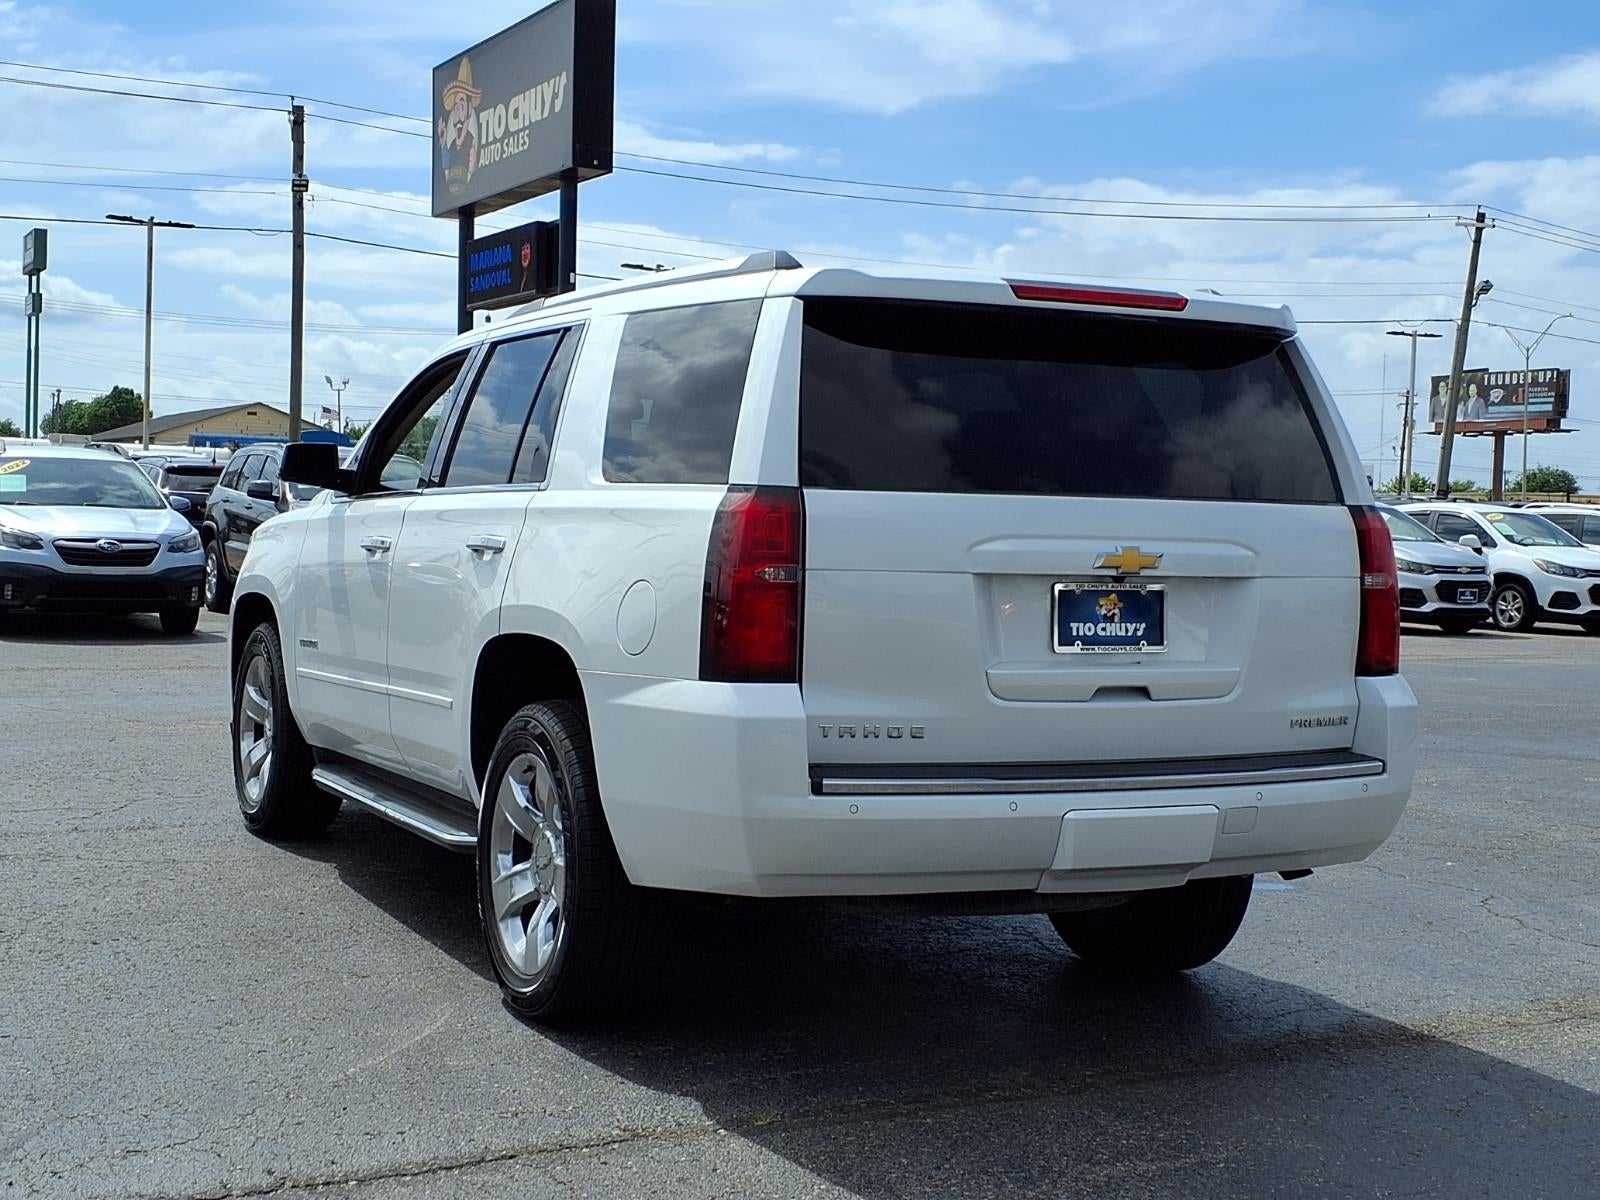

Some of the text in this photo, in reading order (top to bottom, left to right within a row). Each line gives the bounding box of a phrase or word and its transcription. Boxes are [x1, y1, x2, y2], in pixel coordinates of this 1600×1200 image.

[479, 71, 567, 145] TIO CHUY'S
[478, 129, 530, 168] AUTO SALES
[470, 243, 513, 273] MARIANA
[470, 267, 513, 293] SANDOVAL
[1483, 369, 1557, 386] THUNDER UP!
[1070, 622, 1146, 636] TIO CHUY'S
[818, 724, 926, 739] TAHOE
[1289, 715, 1349, 729] PREMIER
